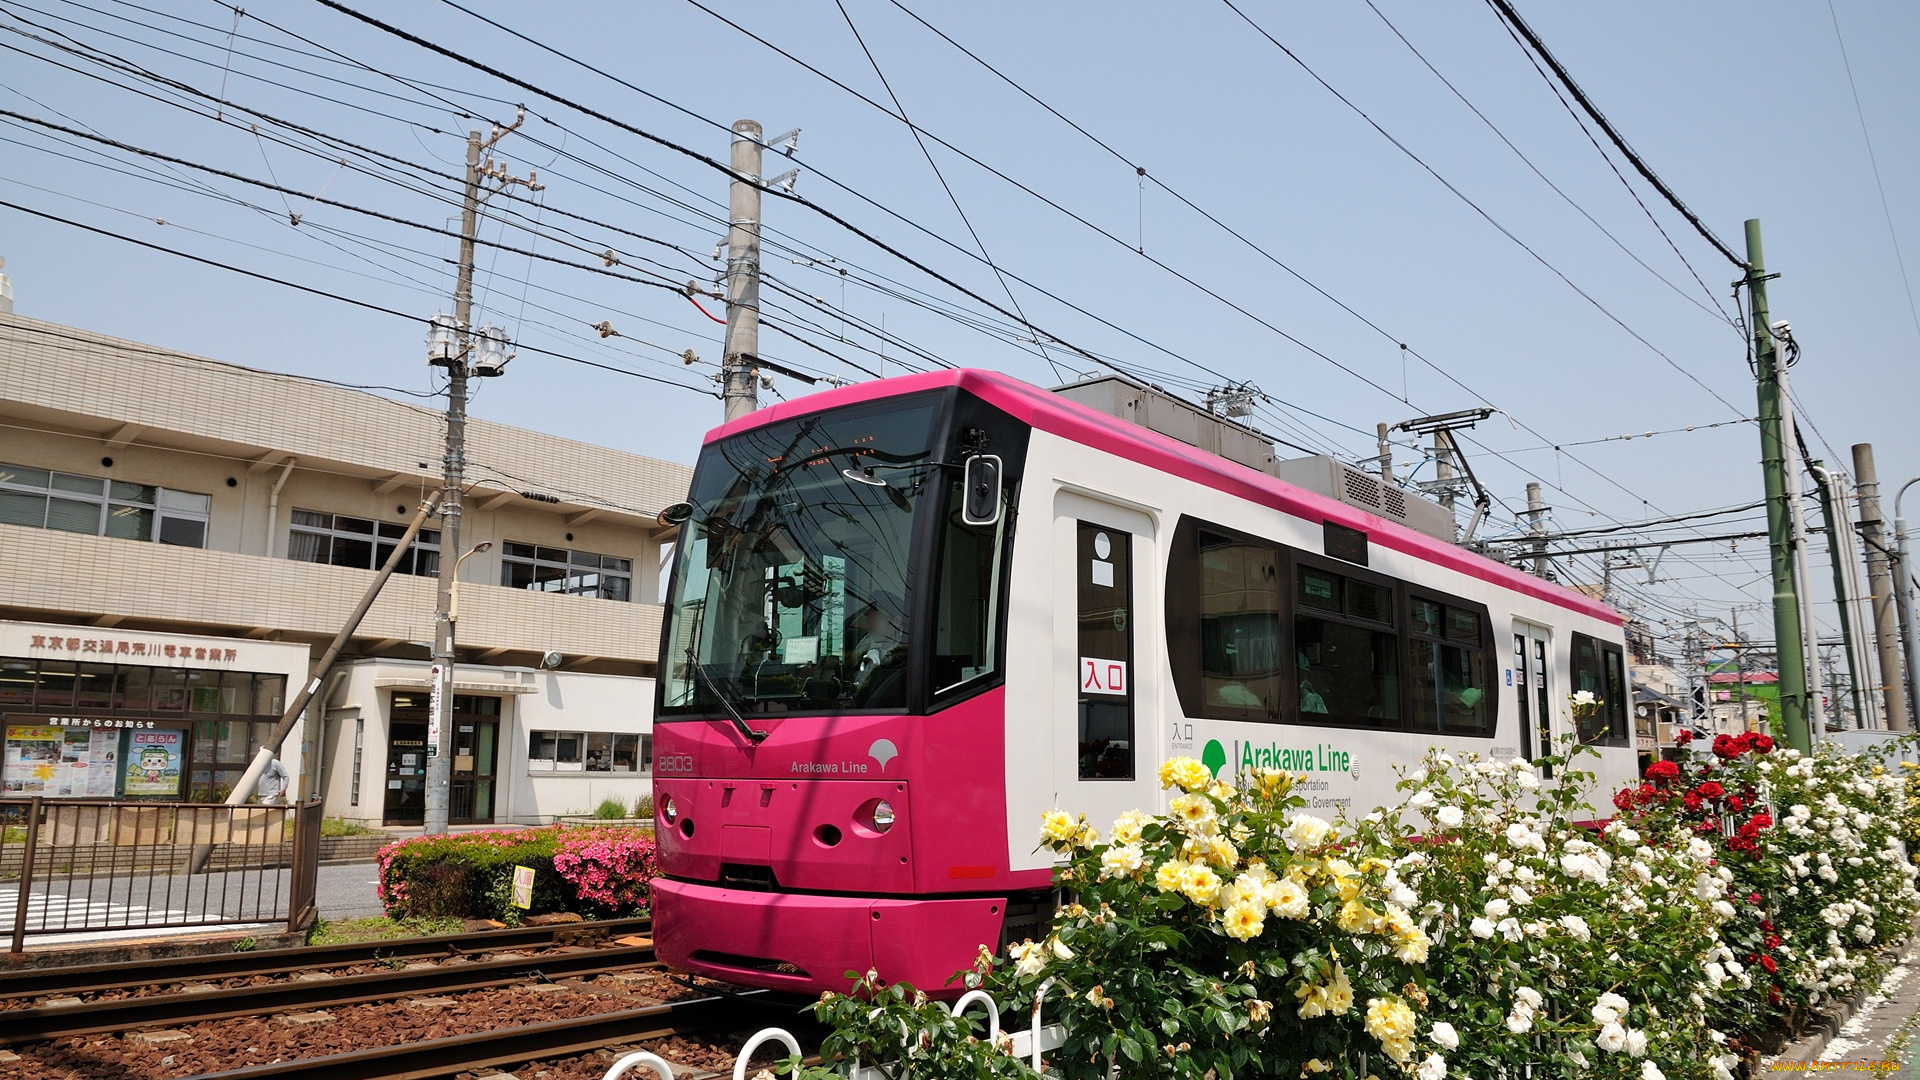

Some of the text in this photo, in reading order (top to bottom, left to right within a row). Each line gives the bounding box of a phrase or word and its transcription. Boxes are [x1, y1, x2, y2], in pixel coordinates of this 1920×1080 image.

[31, 634, 238, 662] 東京都交通局荒川電車営業所
[1084, 661, 1123, 691] 入口
[49, 717, 155, 729] 営業所からのお知らせ
[135, 734, 177, 744] とあらん
[1172, 722, 1193, 741] 入口
[1172, 742, 1194, 750] ENTRANCE
[659, 756, 693, 772] 8803
[1241, 740, 1350, 772] Arakawa Line
[791, 761, 868, 774] Arakawa Line
